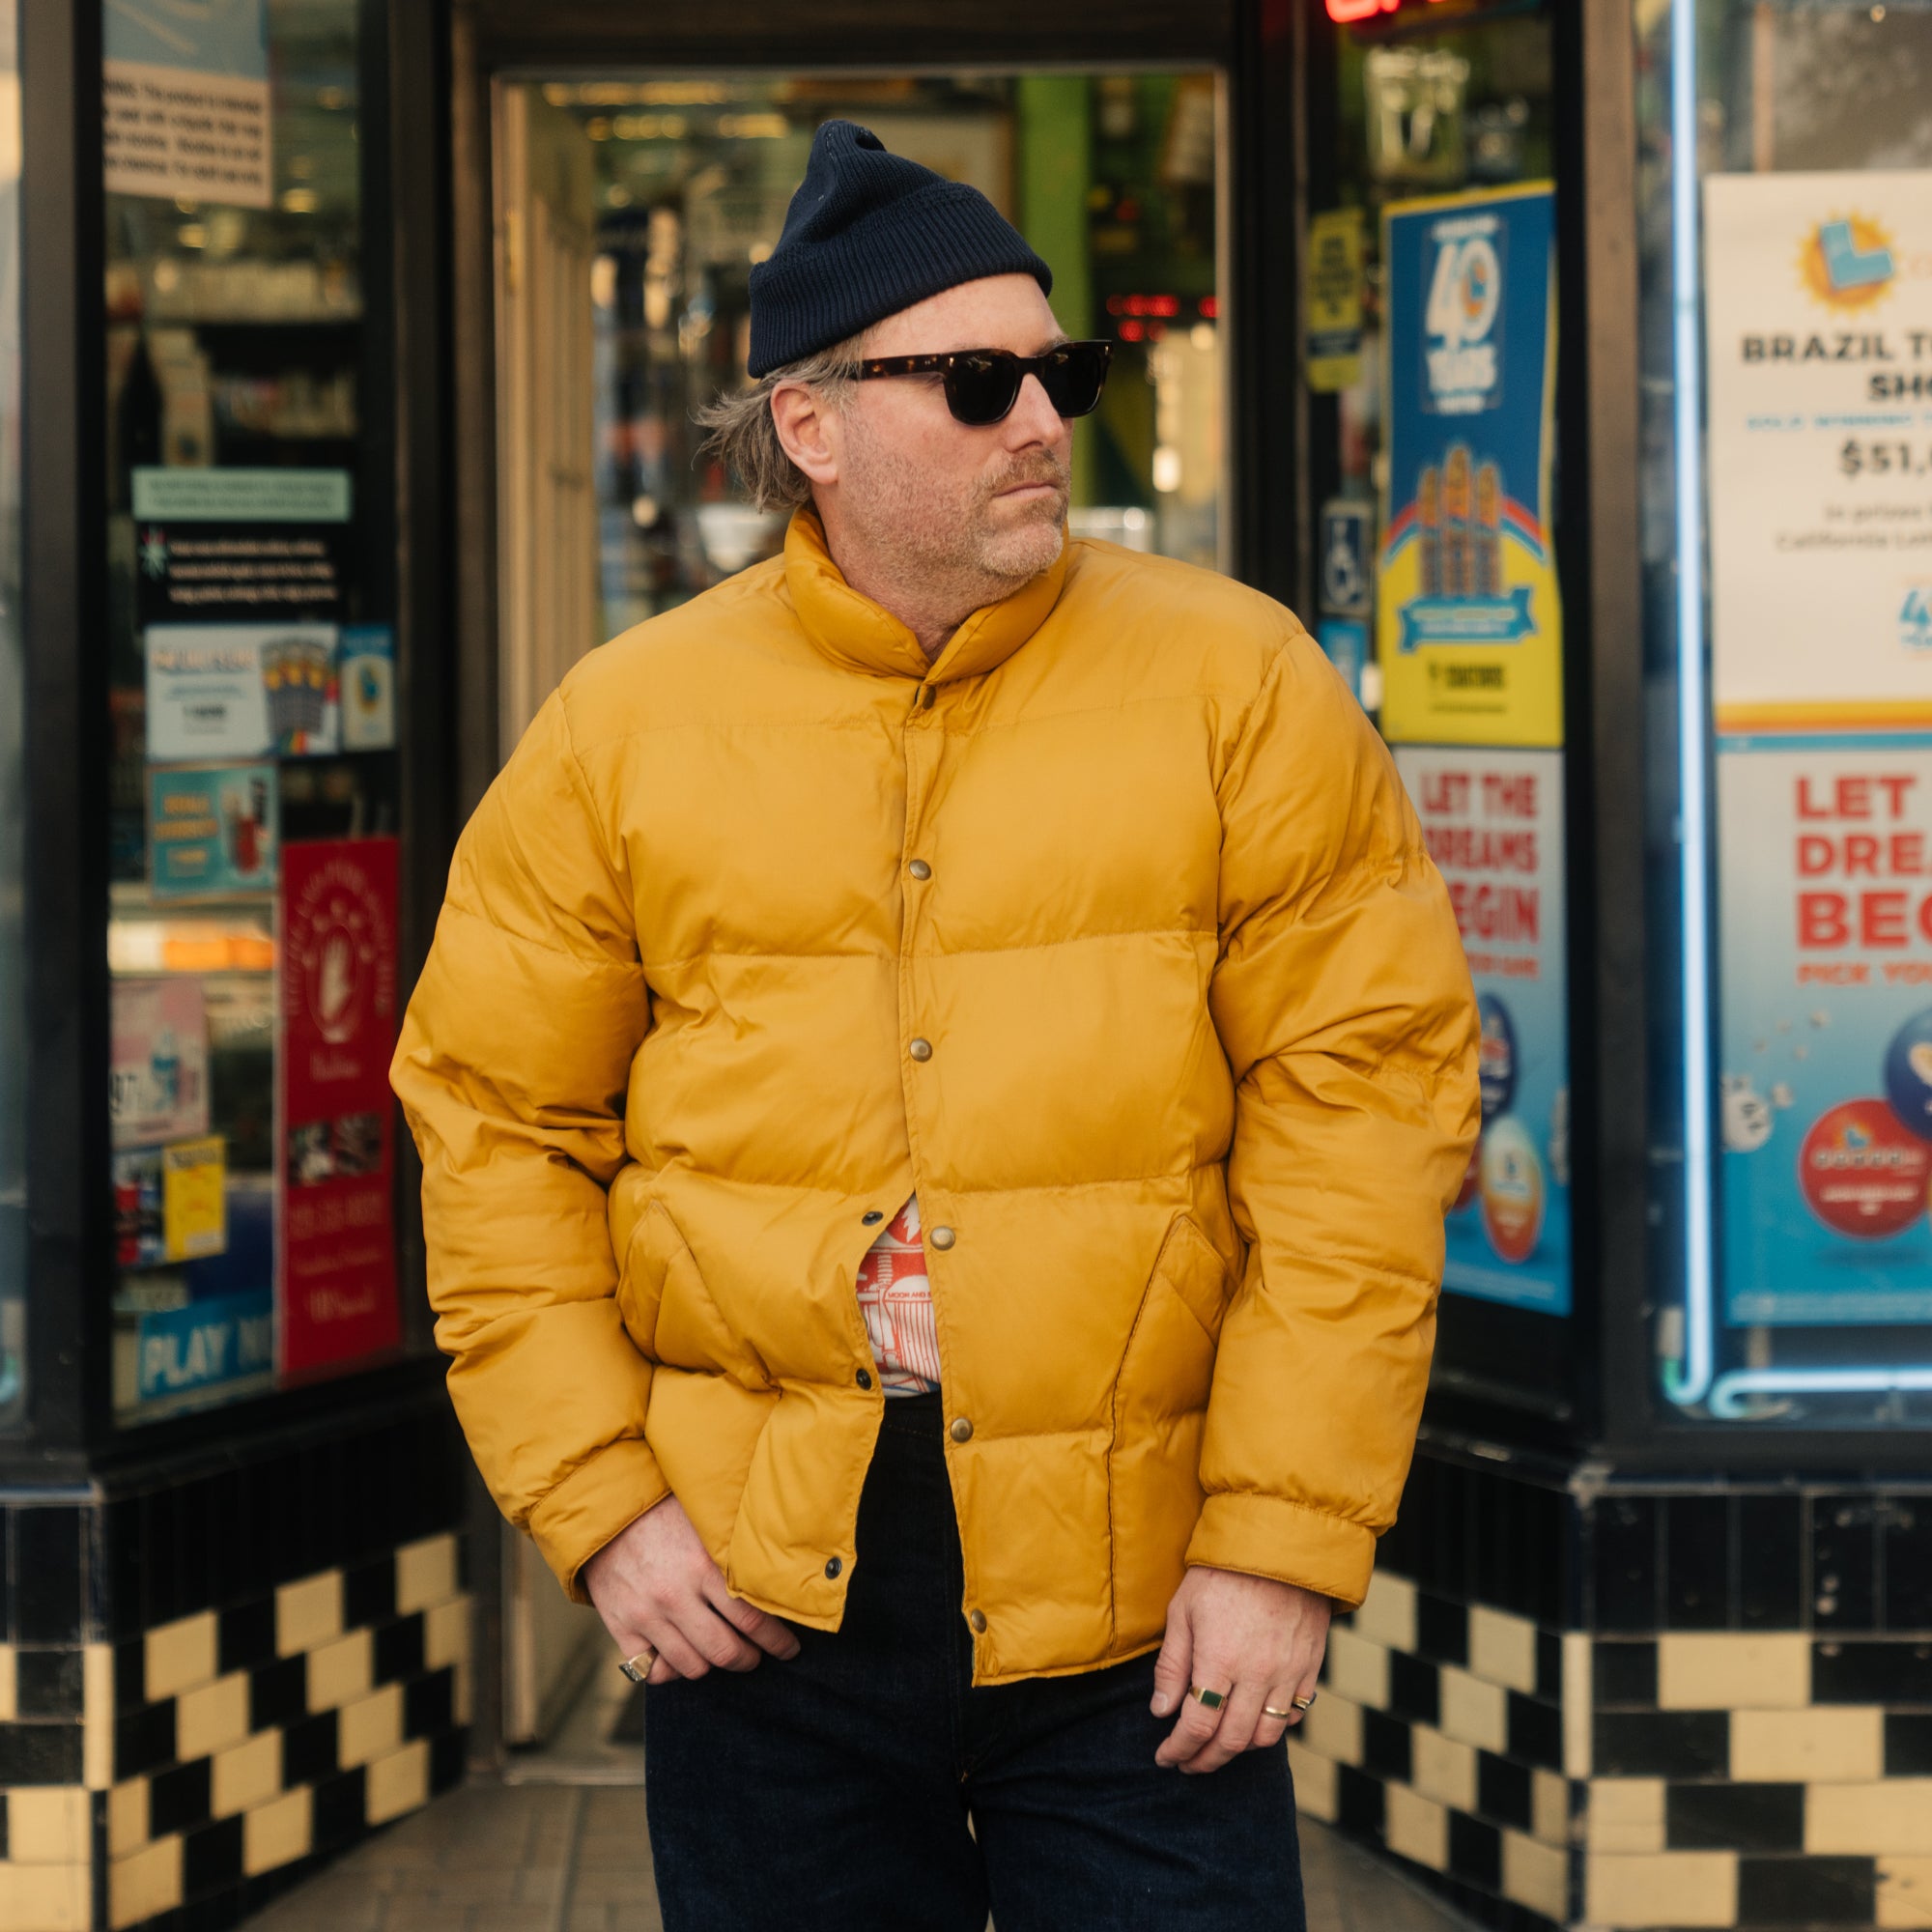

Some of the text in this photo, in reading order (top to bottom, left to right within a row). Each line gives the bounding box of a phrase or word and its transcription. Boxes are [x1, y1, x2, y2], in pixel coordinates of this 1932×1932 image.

[1743, 333, 1892, 363] BRAZIL
[1419, 771, 1538, 819] LET THE
[1796, 774, 1914, 819] LET
[1796, 832, 1932, 878] DRE
[1797, 962, 1870, 986] PICK
[143, 1323, 228, 1393] PLAY
